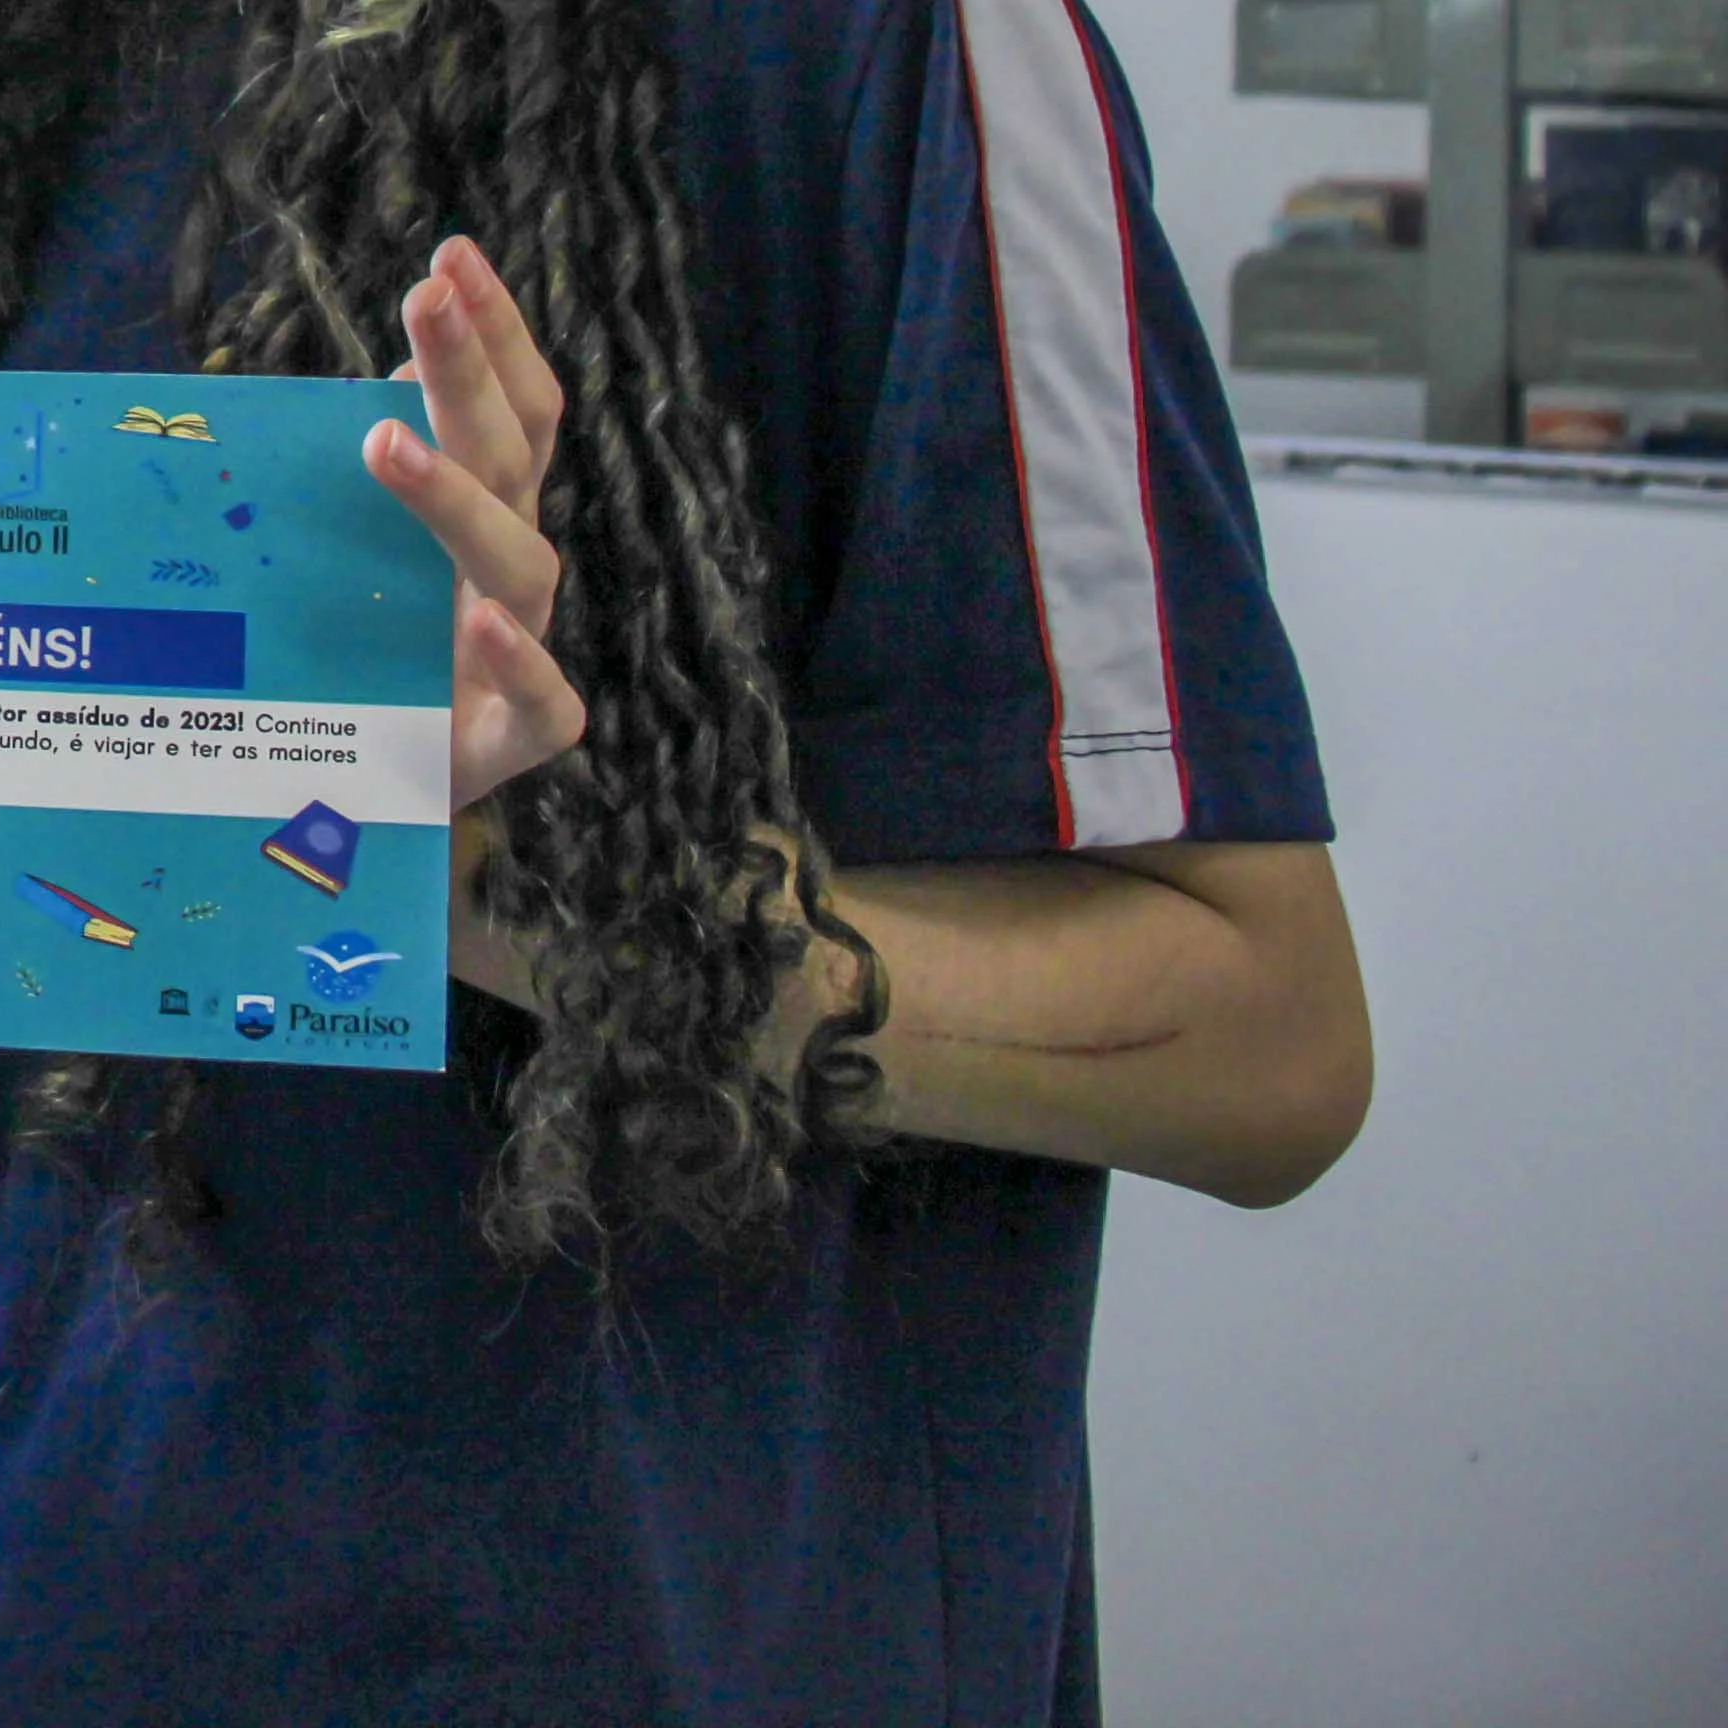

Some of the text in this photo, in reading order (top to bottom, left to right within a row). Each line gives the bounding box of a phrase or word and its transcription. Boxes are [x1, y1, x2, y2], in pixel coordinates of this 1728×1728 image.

[53, 524, 68, 555] II
[37, 704, 129, 727] assíduo
[140, 708, 169, 729] de
[180, 710, 244, 732] 2023!
[255, 714, 357, 737] Continue
[70, 732, 83, 752] é
[94, 735, 155, 760] viajar
[166, 741, 180, 756] e
[190, 739, 222, 758] ter
[233, 744, 258, 760] as
[268, 743, 357, 764] maiores
[289, 1003, 411, 1037] Paraíso
